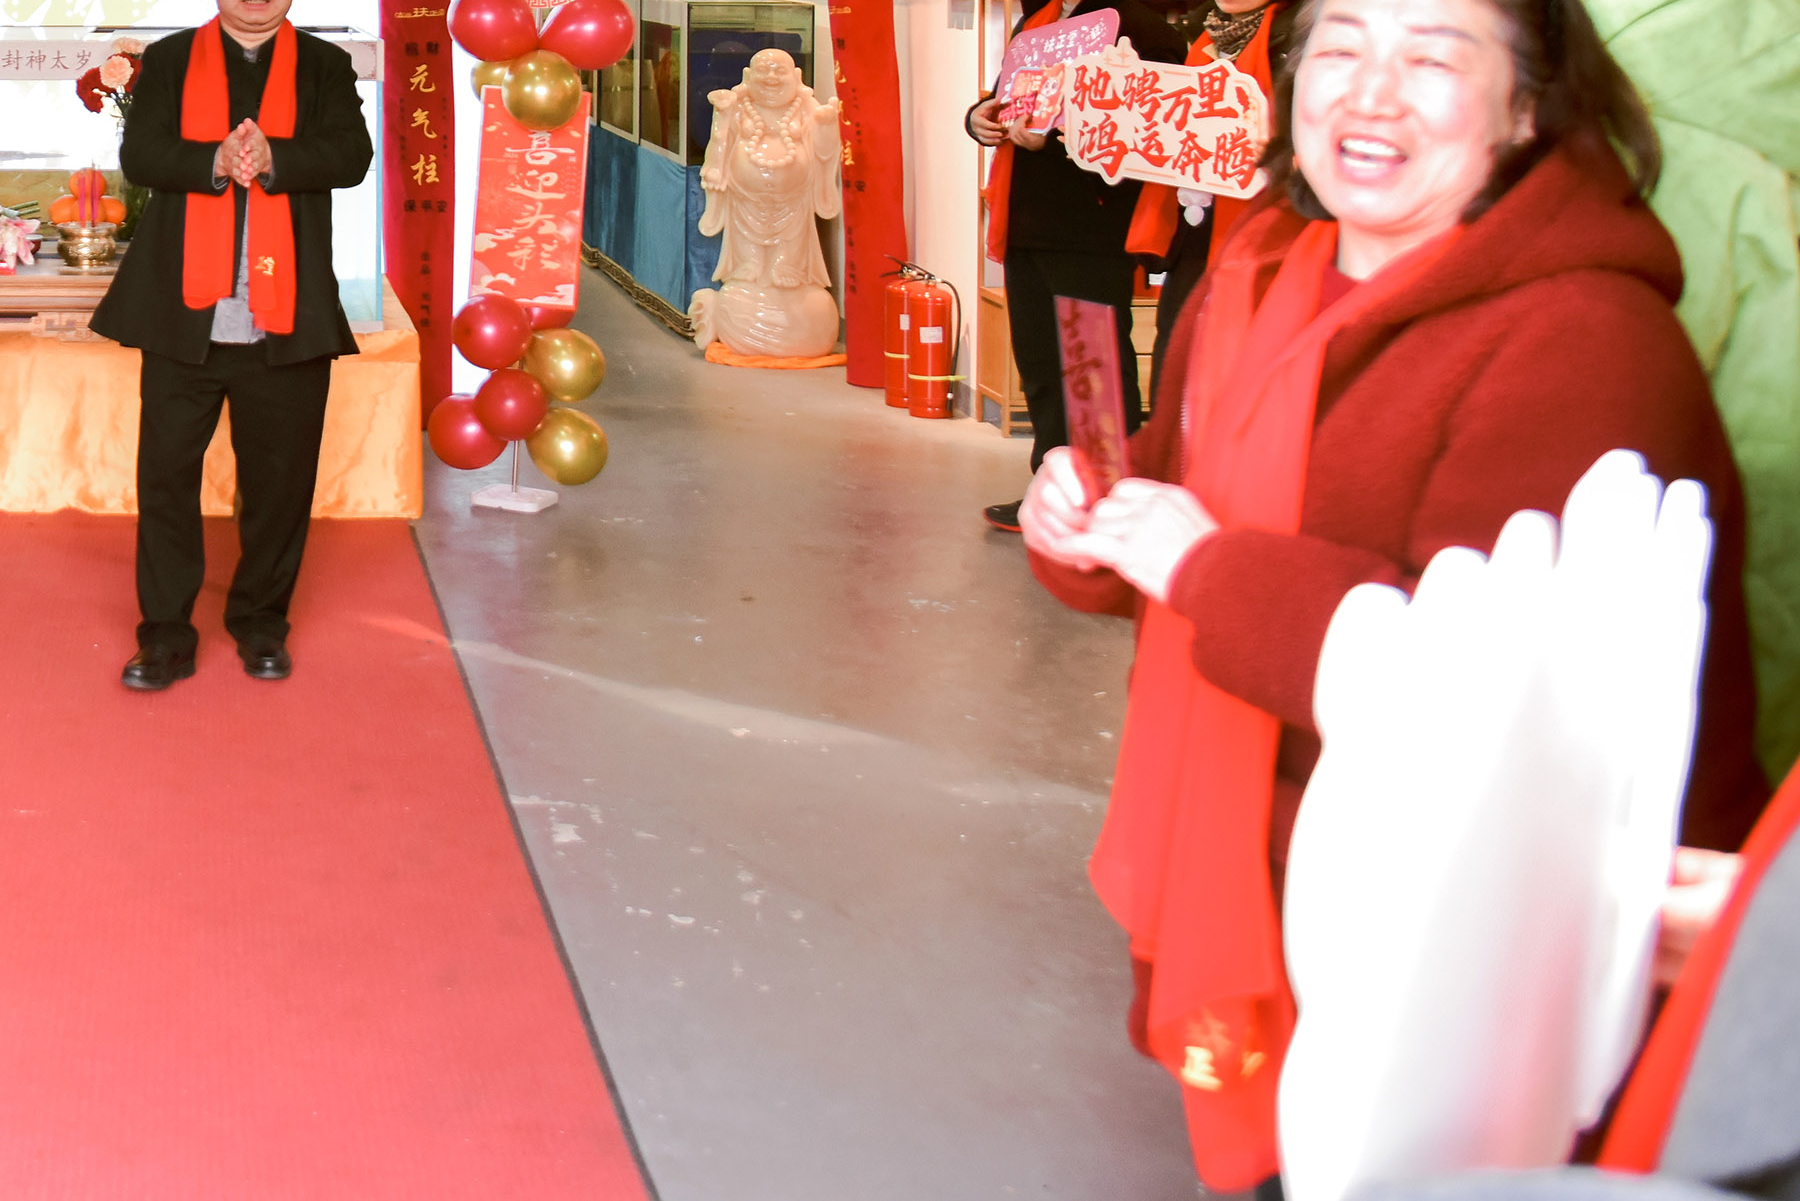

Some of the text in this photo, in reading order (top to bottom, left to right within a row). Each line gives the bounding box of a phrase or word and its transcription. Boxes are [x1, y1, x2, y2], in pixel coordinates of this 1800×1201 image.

[409, 63, 441, 186] 元气柱
[1070, 64, 1240, 132] 驰骋万里
[1077, 112, 1258, 191] 鸿运奔腾
